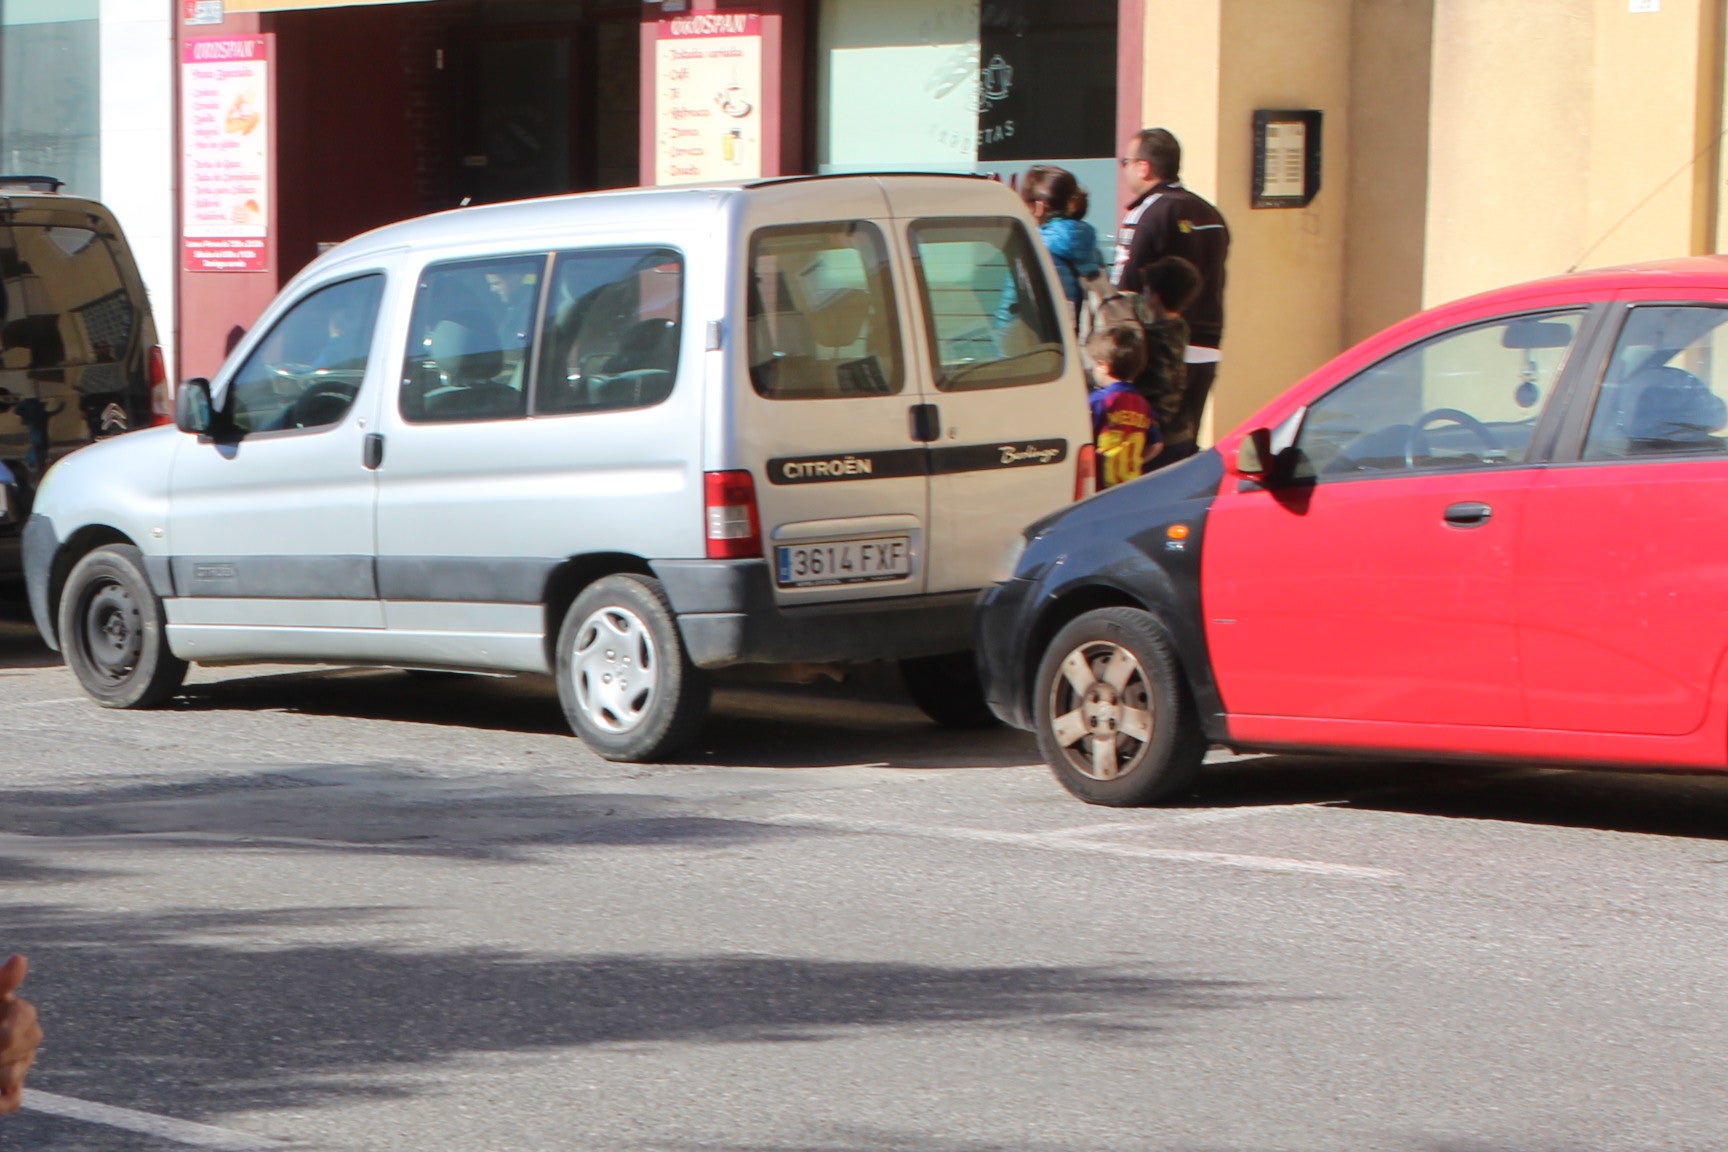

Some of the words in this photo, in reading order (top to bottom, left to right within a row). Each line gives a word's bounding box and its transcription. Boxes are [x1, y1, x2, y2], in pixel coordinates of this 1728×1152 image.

[782, 456, 872, 479] CITROËN
[795, 547, 853, 576] 3614
[861, 543, 903, 572] FXF
